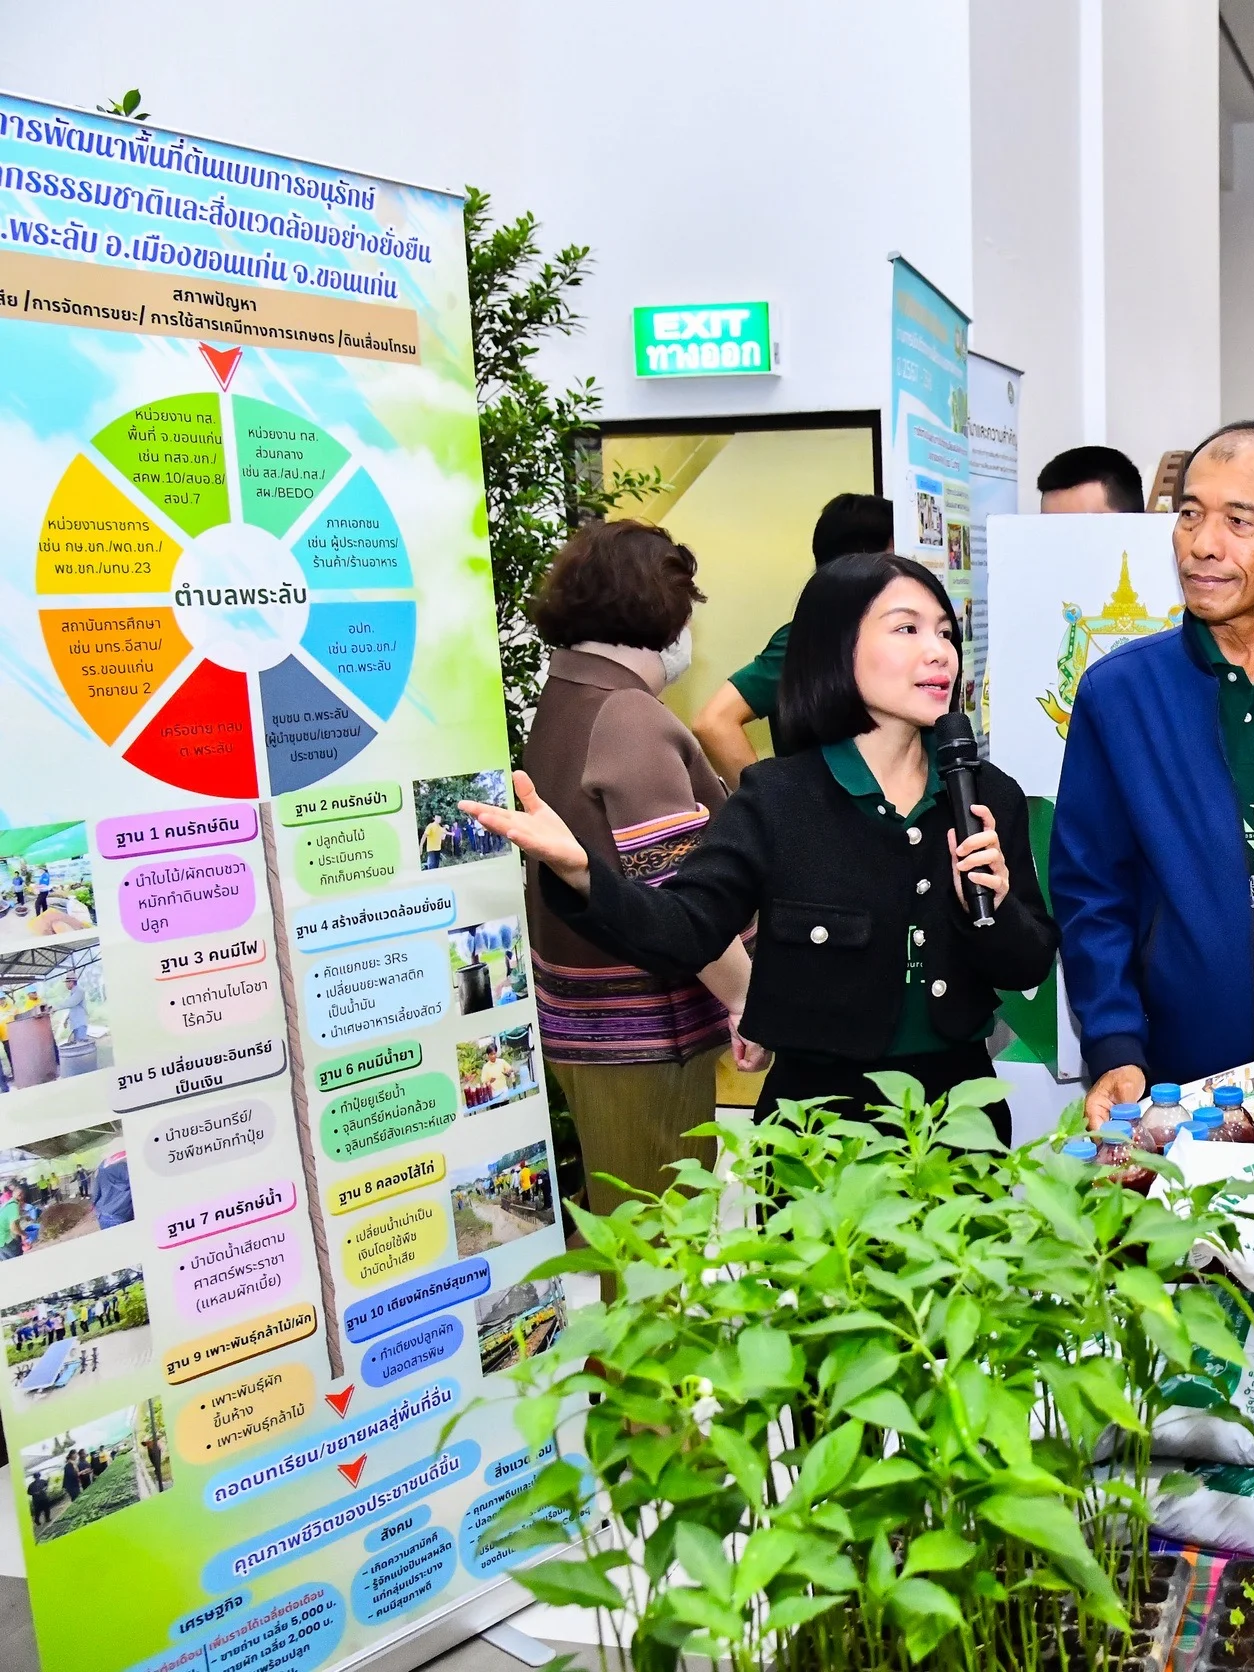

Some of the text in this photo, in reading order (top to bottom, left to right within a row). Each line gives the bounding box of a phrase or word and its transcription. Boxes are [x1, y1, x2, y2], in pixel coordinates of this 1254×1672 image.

[106, 234, 288, 282] อ.เมืองขอนแก่น
[293, 264, 399, 299] จ.ขอนแก่น
[173, 288, 257, 312] สภาพปัญหา
[150, 309, 335, 344] การใช้สารเคมีทางการเกษตร
[653, 309, 750, 340] EXIT
[647, 341, 760, 371] ทางออก
[135, 407, 216, 424] หน่วยงาน ทส.
[128, 424, 222, 445] พื้นที่ จ.ขอนแก่น
[248, 427, 319, 442] หน่วยงาน ทส.
[138, 449, 159, 463] เช่น
[255, 446, 304, 460] ส่วนกลาง
[242, 465, 259, 478] เช่น
[163, 493, 201, 505] สจป.7
[48, 516, 150, 532] หน่วยงานราชการ
[326, 519, 380, 529] ภาคเอกชน
[38, 538, 60, 553] เช่น
[308, 535, 326, 548] เช่น
[313, 554, 398, 568] ร้านค้า/ร้านอาหาร
[175, 582, 307, 607] ตำบลพระลับ
[61, 617, 162, 633] สถาบันการศึกษา
[348, 623, 375, 634] อปท.
[69, 640, 90, 655] เช่น
[328, 642, 347, 655] เช่น
[81, 660, 154, 676] รร.ขอนแก่น
[338, 659, 392, 674] ทต.พระลับ
[88, 682, 152, 698] วิทยายน 2
[272, 707, 349, 726] ชุมชน ต.พระลับ
[290, 747, 338, 763] ประชาชน)
[295, 791, 388, 818] ฐาน 2 คนรักษ์ป่า
[116, 817, 240, 848] ฐาน 1 คนรักษ์ดิน
[316, 829, 366, 850] ปลูกต้นไม้
[318, 849, 374, 867] ประเมินการ
[135, 862, 247, 888] นำใบไม้/ผักตบชวา
[319, 864, 395, 887] กักเก็บคาร์บอน
[138, 884, 240, 910] หมักทำดินพร้อม
[140, 916, 169, 934] ปลูก
[296, 897, 452, 940] ฐาน 4 สร้างสิ่งแวดล้อมยั่งยืน
[160, 940, 259, 974] ฐาน 3 คนมีไฟ
[323, 952, 408, 979] คัดแยกขยะ 3Rs
[181, 979, 268, 1007] เตาถ่านไบโอชา
[326, 968, 424, 1000] เปลี่ยนขยะพลาสติก
[183, 1010, 223, 1029] ไร้ควัน
[328, 998, 376, 1019] เป็นน้ำมัน
[330, 1002, 443, 1040] นำเศษอาหารเลี้ยงสัตว์
[117, 1039, 273, 1090] ฐาน 5 เปลี่ยนขยะอินทรีย์
[319, 1047, 415, 1086] ฐาน 6 คนมีน้ำยา
[175, 1073, 224, 1095] เป็นเงิน
[340, 1083, 406, 1115] ทำปุ๋ยยูเรียน้ำ
[342, 1098, 437, 1137] จุลินทรีย์หน่อกล้วย
[168, 1127, 265, 1164] วัชพืชหมักทำปุ๋ย
[344, 1112, 457, 1157] จุลินทรีย์สังเคราะห์แสง
[338, 1159, 435, 1207] ฐาน 8 คลองไส้ไก่
[167, 1187, 283, 1238] ฐาน 7 คนรักษ์น้ำ
[355, 1207, 434, 1244] เปลี่ยนน้ำเน่าเป็น
[190, 1231, 287, 1271] บำบัดน้ำเสียตาม
[358, 1233, 418, 1262] เงินโดยใช้พืช
[193, 1252, 286, 1291] ศาสตร์พระราชา
[360, 1251, 416, 1280] บำบัดน้ำเสีย
[195, 1272, 283, 1313] (แหลมผักเบี้ย)
[346, 1267, 489, 1333] ฐาน 10 เตียงผักรักษ์สุขภาพ
[166, 1312, 312, 1376] ฐาน 9 เพาะพันธุ์กล้าไม้/ผัก
[382, 1345, 446, 1380] ปลอดสารพิษ
[211, 1372, 283, 1409] เพาะพันธุ์ผัก
[213, 1403, 254, 1429] ขึ้นห้าง
[217, 1402, 306, 1449] เพาะพันธุ์กล้าไม้
[213, 1386, 453, 1503] ถอดบทเรียน/ขยายผลสู่พื้นที่อื่น
[494, 1442, 553, 1479] สิ่งแวดอม
[233, 1454, 461, 1575] คุณภาพชีวิตของประชาชนดีขึ้น
[380, 1516, 413, 1543] สังคม
[178, 1593, 244, 1635] เศรษฐกิจ
[263, 1621, 289, 1641] เฉลี่ย
[291, 1603, 325, 1627] 5,000
[260, 1638, 287, 1659] เฉลี่ย
[288, 1621, 322, 1645] 2,000
